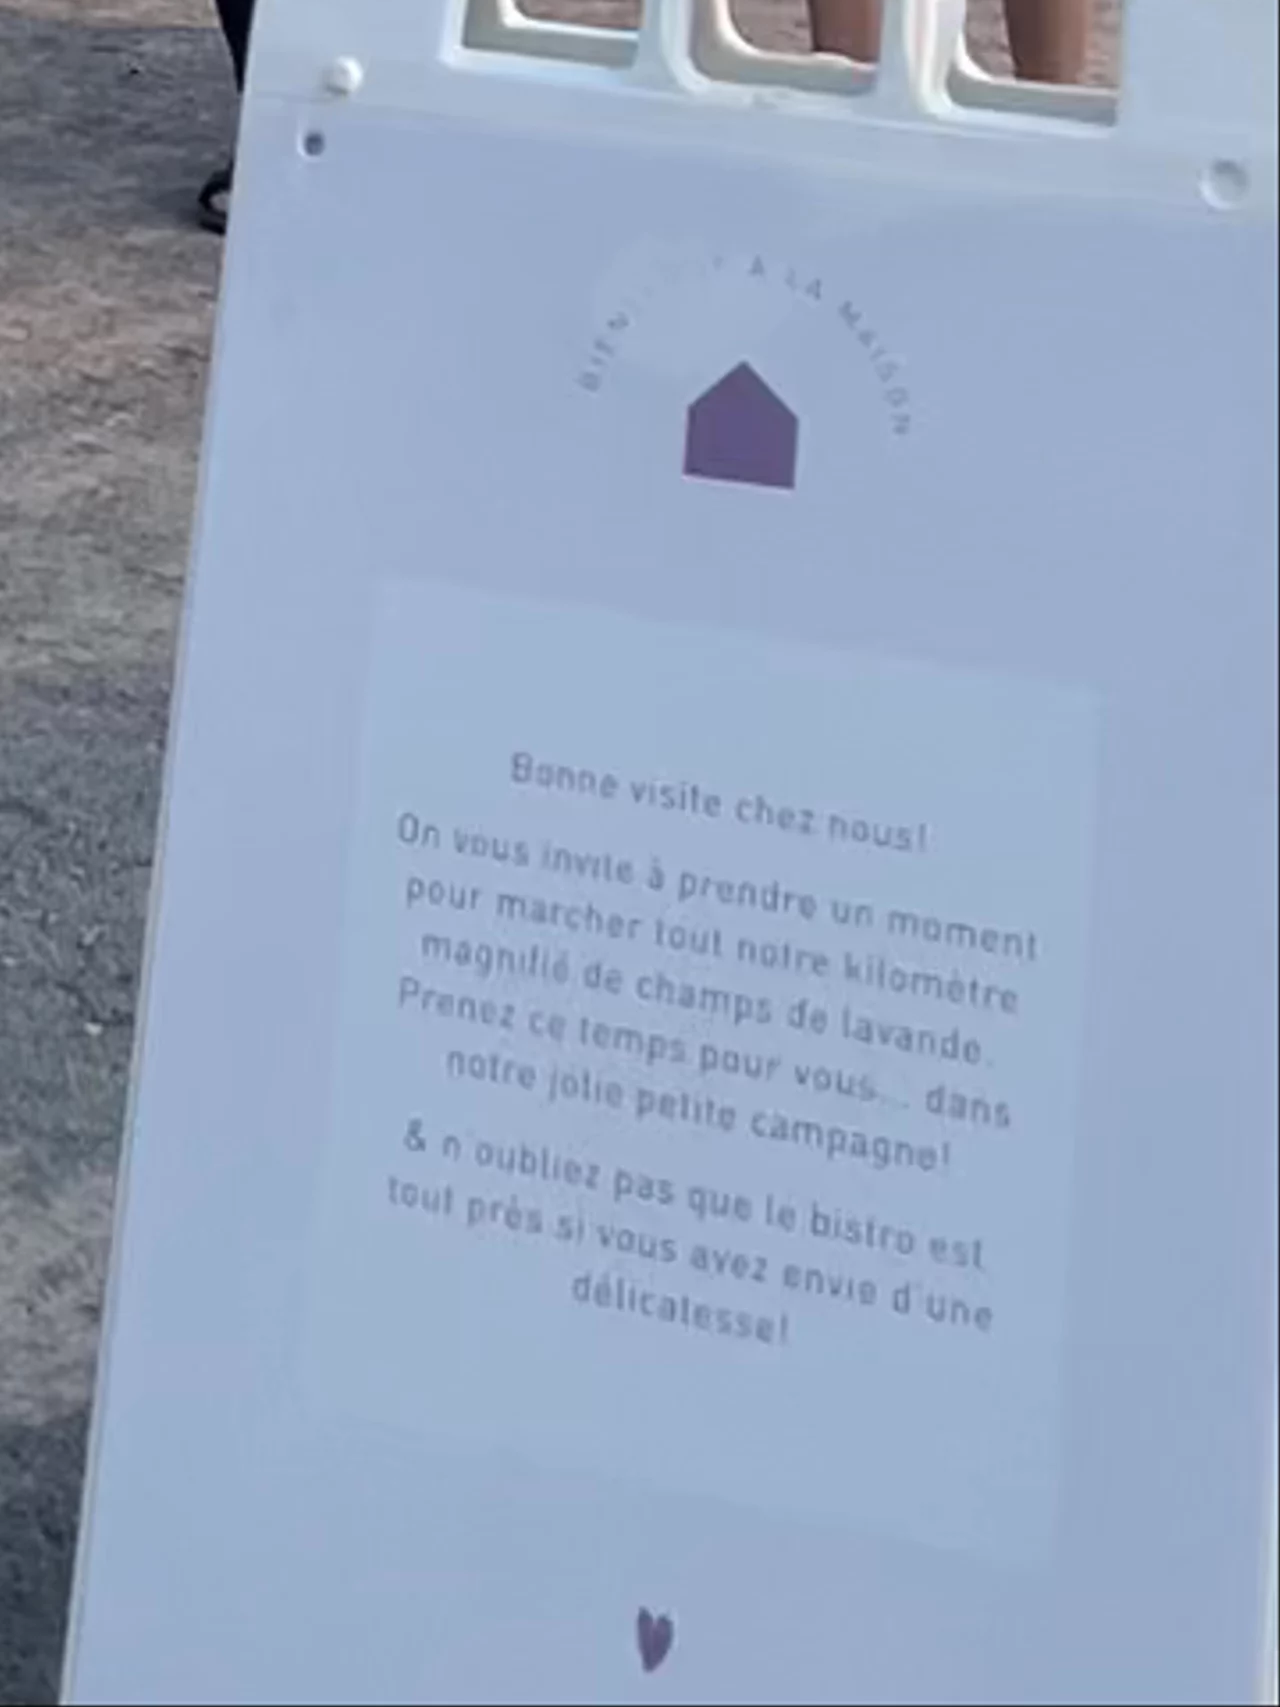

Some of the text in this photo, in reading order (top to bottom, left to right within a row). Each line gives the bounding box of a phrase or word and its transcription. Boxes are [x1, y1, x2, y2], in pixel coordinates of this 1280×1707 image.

[510, 751, 929, 854] Bonne visite chez nous!
[396, 811, 441, 849] On
[453, 826, 531, 868] vous
[541, 839, 635, 885] invite
[677, 869, 818, 921] prendre
[830, 897, 874, 929] un
[887, 908, 1038, 962] moment
[405, 875, 482, 912] pour
[495, 892, 643, 940] marcher
[655, 917, 724, 959] tout
[737, 936, 830, 977] notre
[396, 975, 516, 1030] Prenez
[527, 1009, 567, 1045] ce
[579, 1015, 687, 1066] temps
[699, 1042, 782, 1080] pour
[925, 1084, 1011, 1129] dans
[582, 958, 624, 995] de
[635, 970, 773, 1026] champs
[786, 997, 829, 1035] de
[445, 1050, 952, 1172] notre jolie petite campagne!
[387, 1175, 454, 1216] tout
[554, 1212, 585, 1242] si
[596, 1223, 678, 1263] vous
[690, 1244, 769, 1284] avez
[783, 1262, 878, 1305] envie
[402, 1117, 427, 1152] &
[613, 1169, 676, 1205] pas
[686, 1185, 753, 1224] que
[765, 1194, 797, 1231] le
[809, 1200, 915, 1256] bistro
[929, 1234, 984, 1270] est
